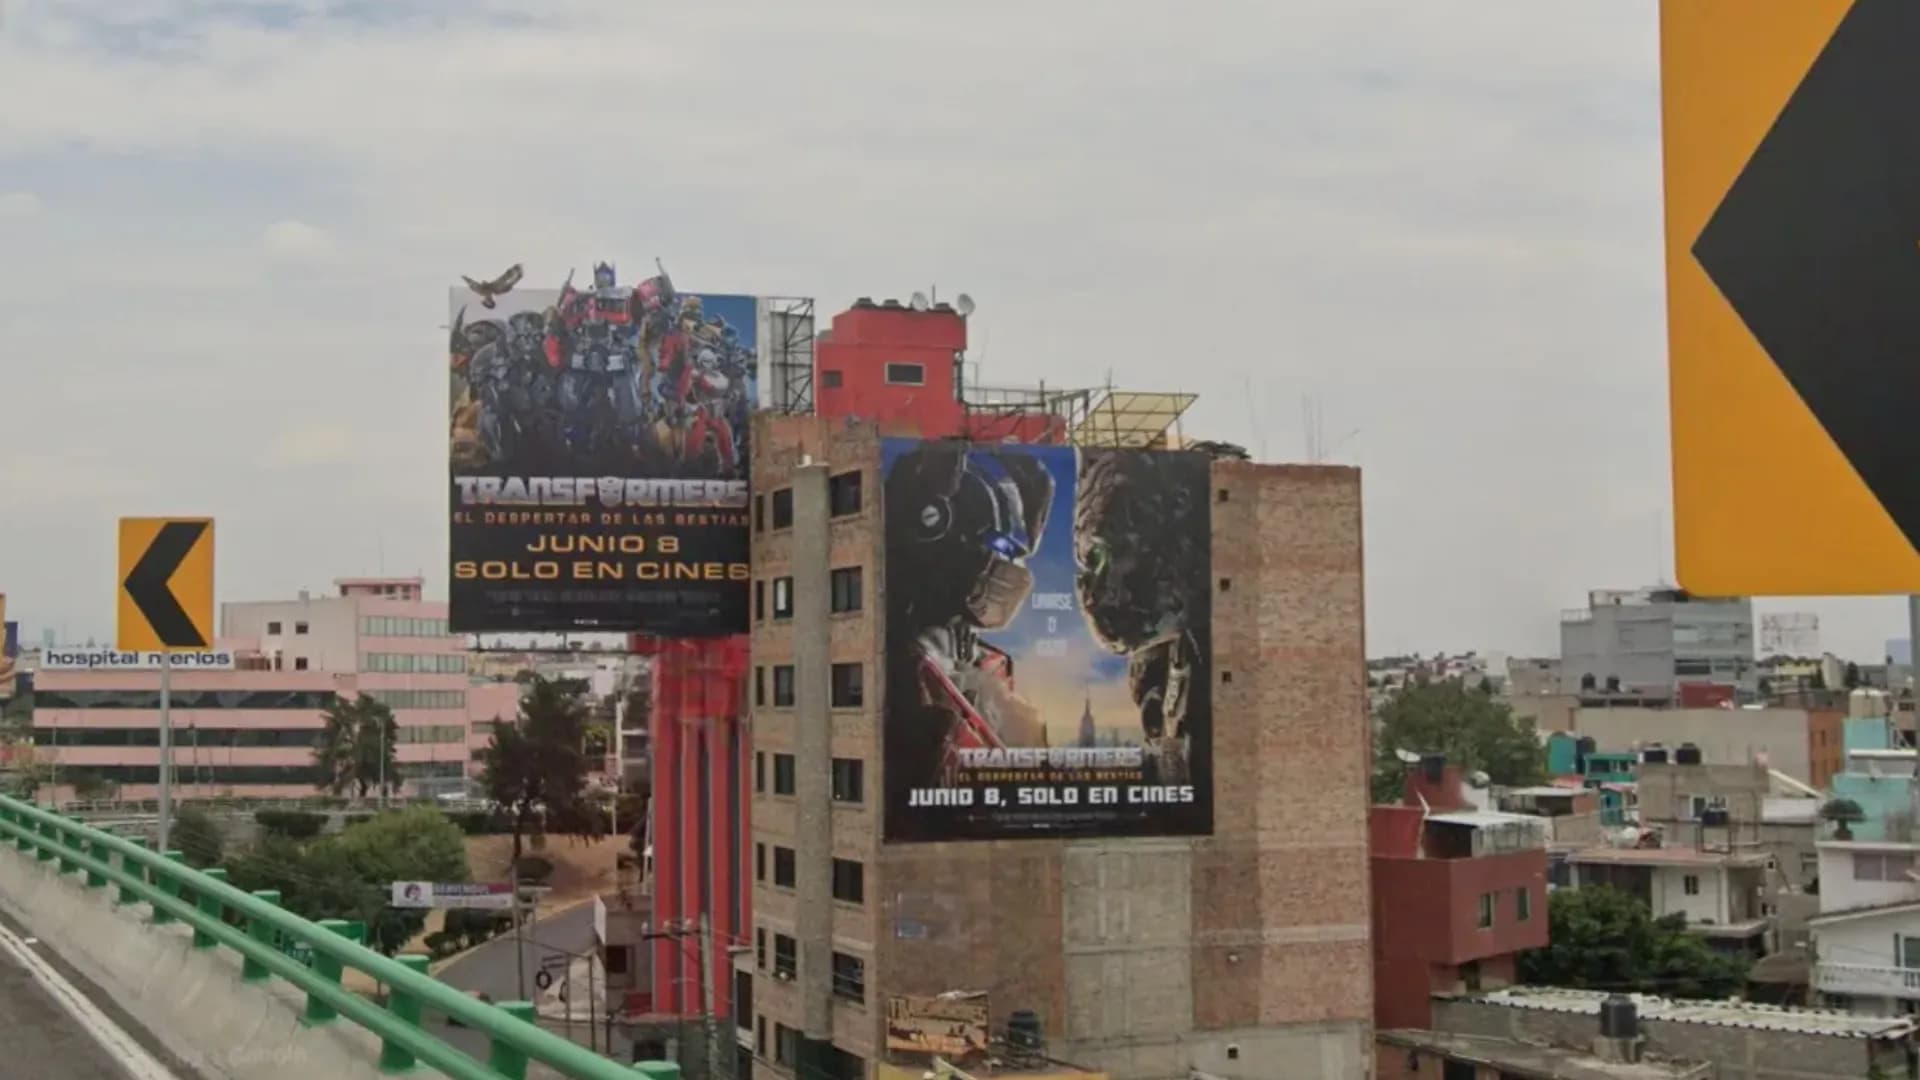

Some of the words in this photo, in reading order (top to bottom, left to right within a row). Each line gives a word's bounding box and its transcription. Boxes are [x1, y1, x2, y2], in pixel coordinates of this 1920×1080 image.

[454, 476, 748, 507] TRANSFORMERS
[454, 511, 473, 524] EL
[601, 511, 622, 525] DE
[526, 534, 645, 553] JUNIO
[657, 535, 680, 553] 8
[454, 561, 560, 579] SOLO
[572, 561, 623, 578] EN
[636, 562, 749, 580] CINES
[47, 651, 138, 667] hospital
[908, 788, 974, 807] JUNIO
[984, 787, 1007, 807] 8,
[1018, 787, 1079, 805] SOLO
[1088, 787, 1118, 804] EN
[1127, 785, 1194, 803] CINES
